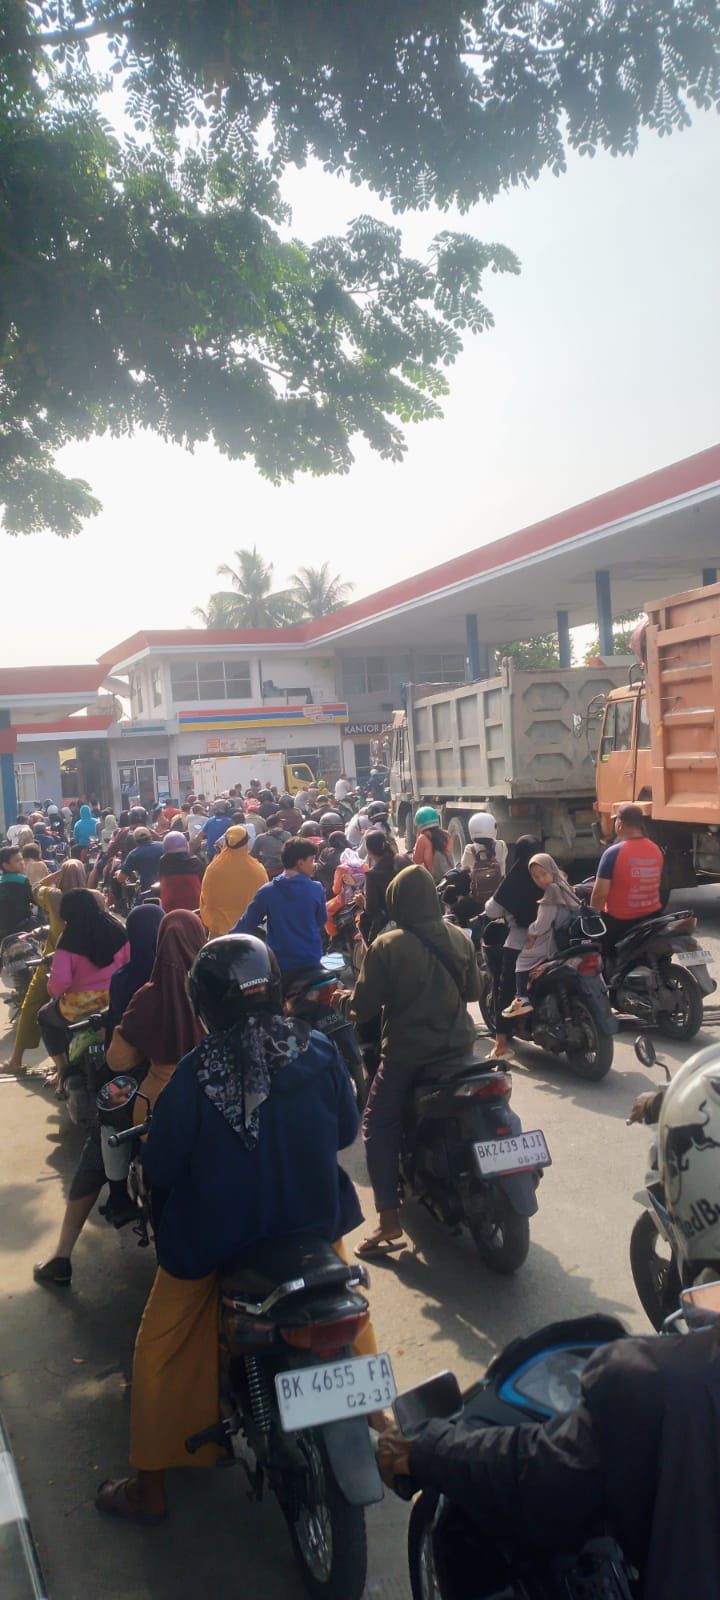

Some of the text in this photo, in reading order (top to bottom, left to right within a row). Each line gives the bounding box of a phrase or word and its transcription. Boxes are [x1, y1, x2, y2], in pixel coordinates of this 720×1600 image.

[344, 723, 379, 734] KANTOR
[240, 977, 269, 990] HONDA
[281, 1359, 390, 1400] BK 4655 FA
